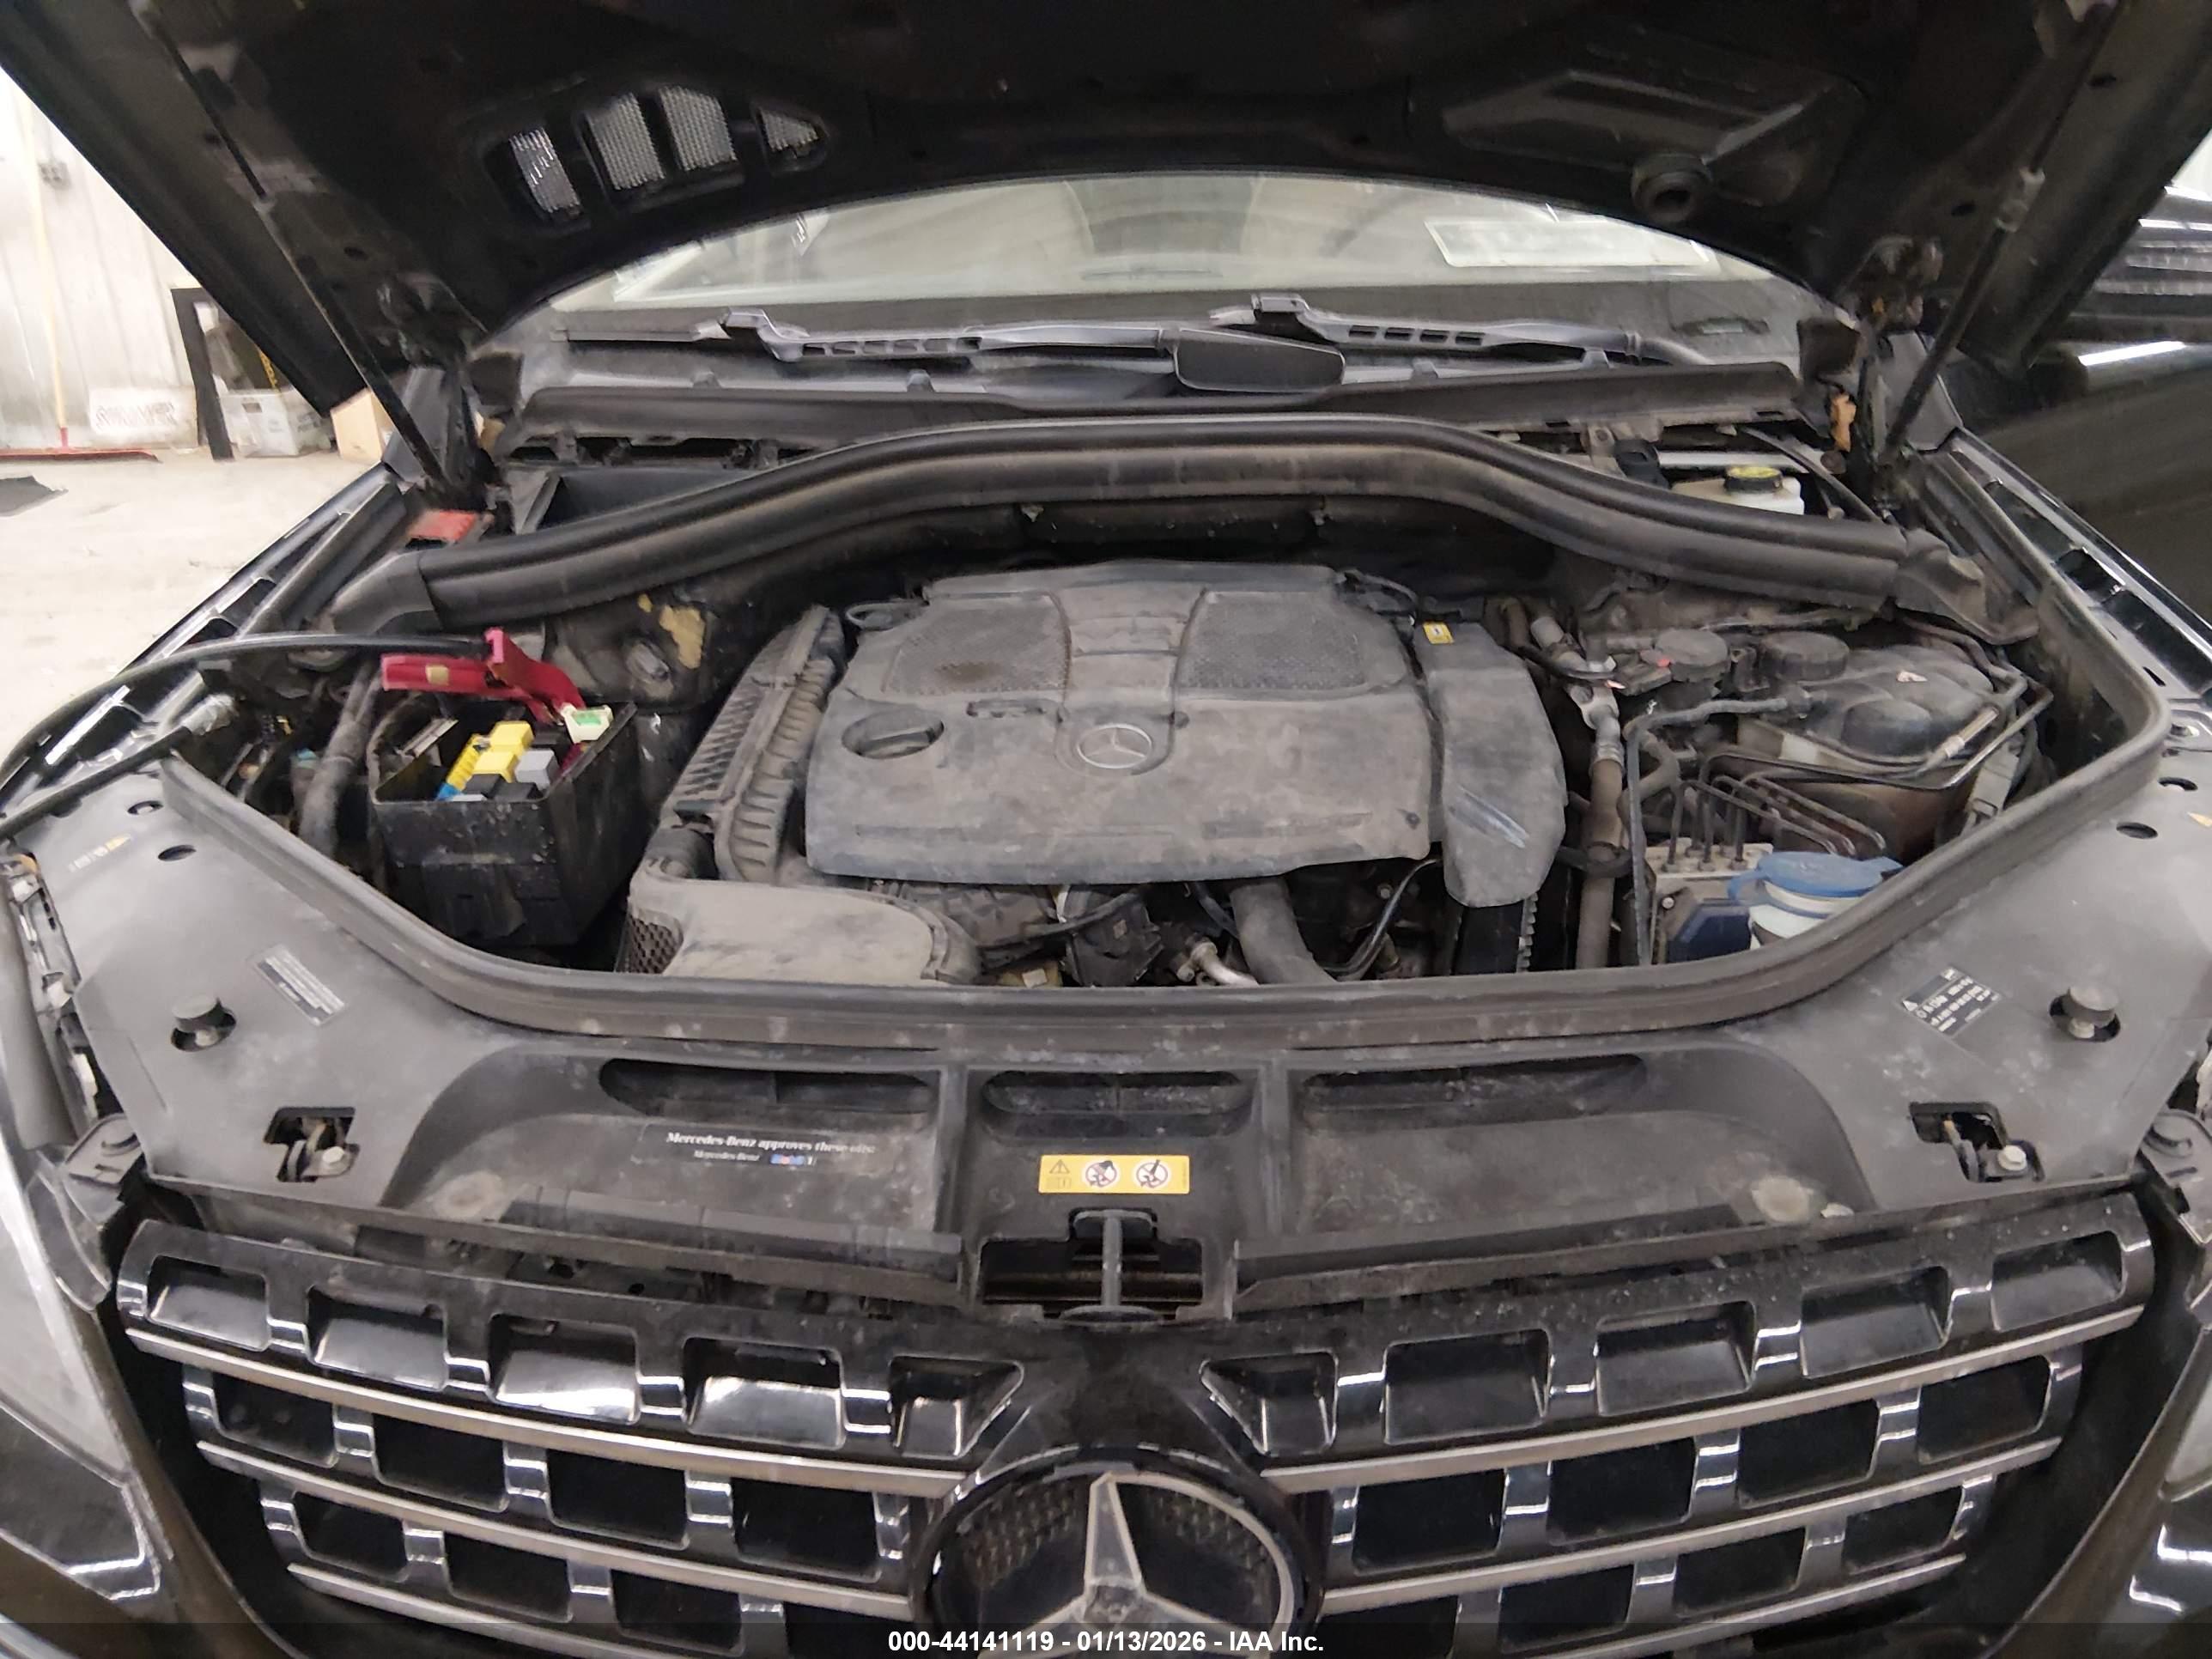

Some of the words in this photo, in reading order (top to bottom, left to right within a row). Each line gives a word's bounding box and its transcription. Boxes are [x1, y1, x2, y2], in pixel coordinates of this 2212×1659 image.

[666, 1132, 757, 1147] Mercedes-Benz
[757, 1139, 812, 1151] approves
[814, 1141, 848, 1152] these
